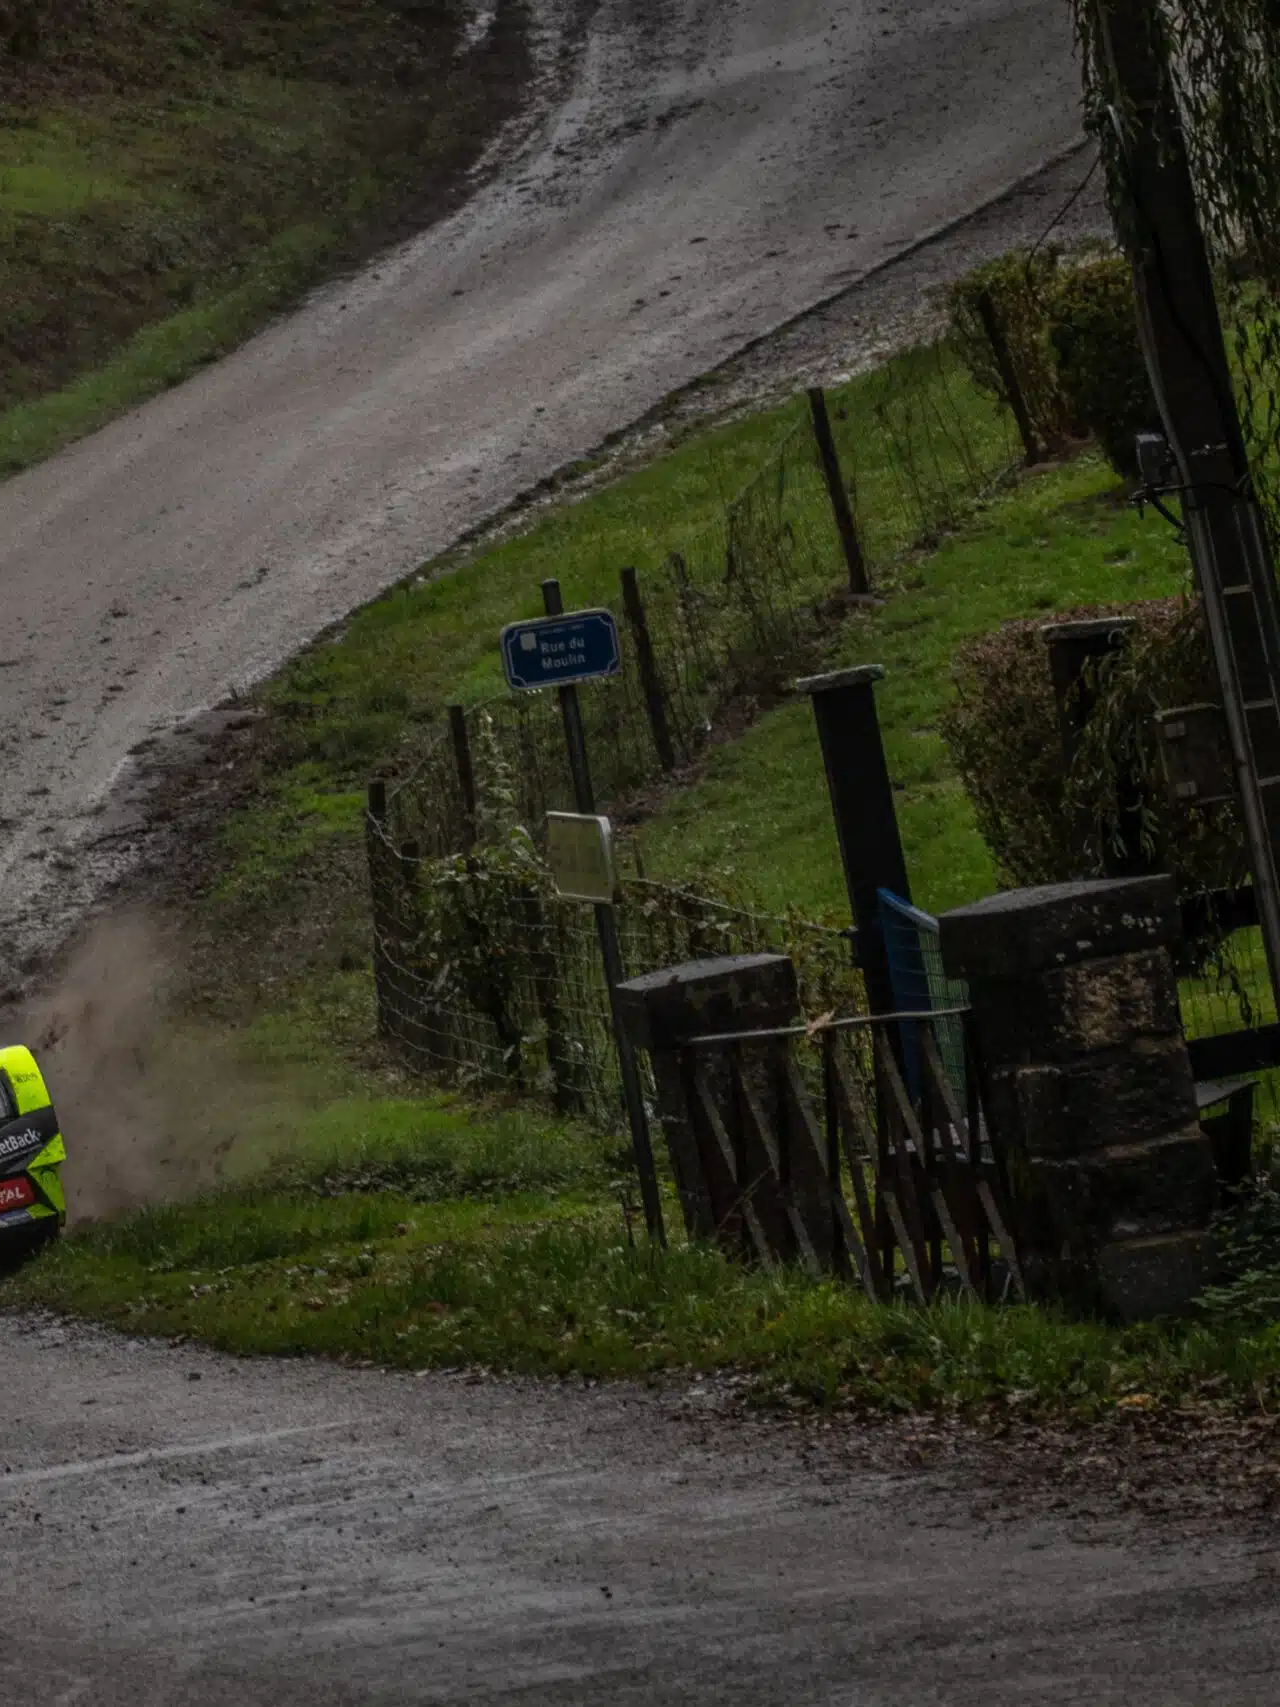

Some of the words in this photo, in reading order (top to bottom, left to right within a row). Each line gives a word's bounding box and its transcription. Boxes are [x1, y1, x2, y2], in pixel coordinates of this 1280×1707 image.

[540, 640, 566, 653] Rue
[569, 636, 586, 649] du
[541, 653, 587, 669] Moulin
